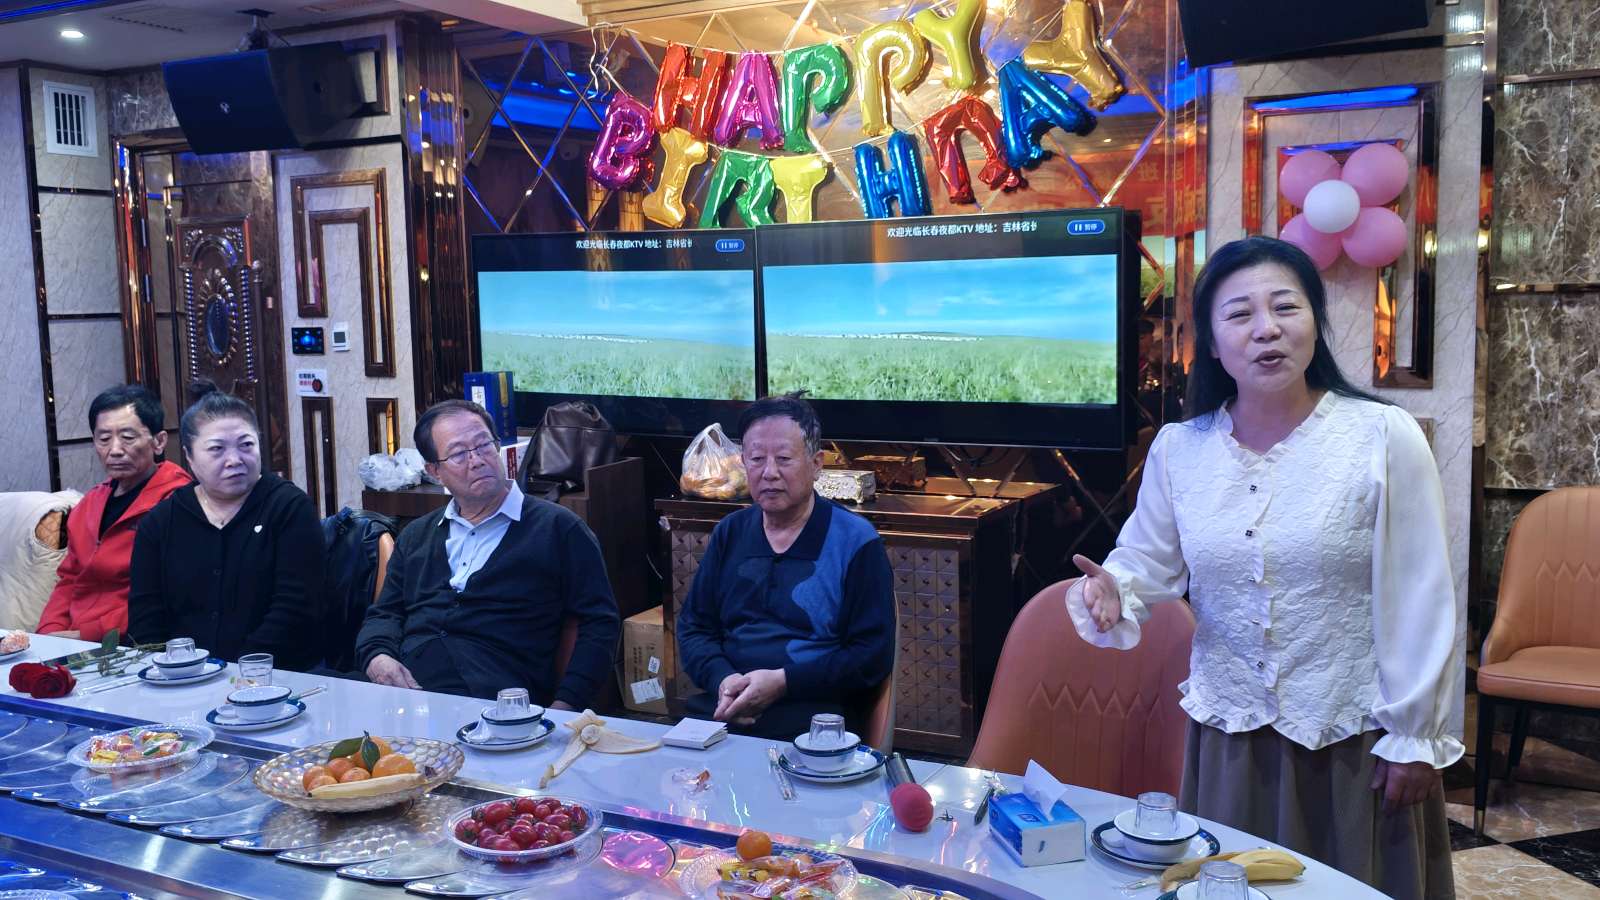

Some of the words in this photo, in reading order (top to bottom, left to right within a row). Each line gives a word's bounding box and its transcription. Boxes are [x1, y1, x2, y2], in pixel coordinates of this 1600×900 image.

[653, 0, 982, 152] HAPPY
[887, 224, 974, 238] 欢迎光临长春夜都KTV
